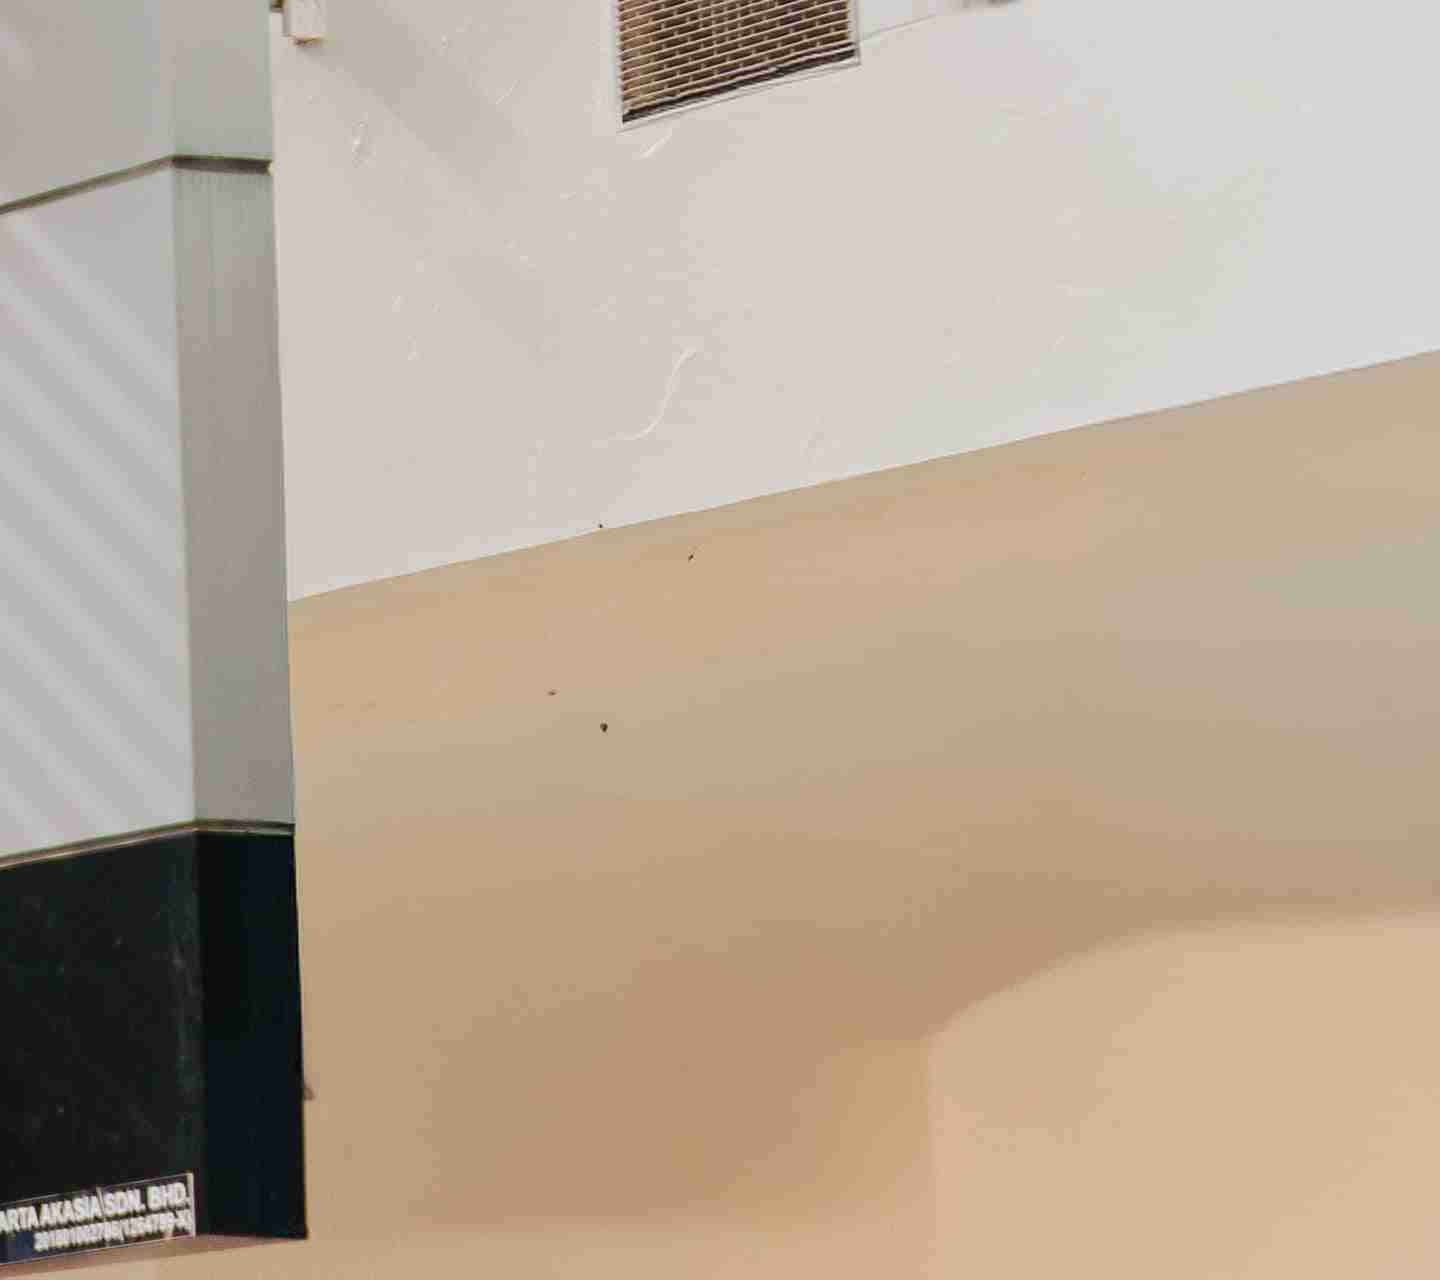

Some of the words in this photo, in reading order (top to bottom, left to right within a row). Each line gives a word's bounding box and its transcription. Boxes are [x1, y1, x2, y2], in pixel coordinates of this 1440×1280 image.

[39, 1194, 102, 1226] AKASIA
[103, 1187, 146, 1216] SDN.
[147, 1181, 191, 1211] BHD.
